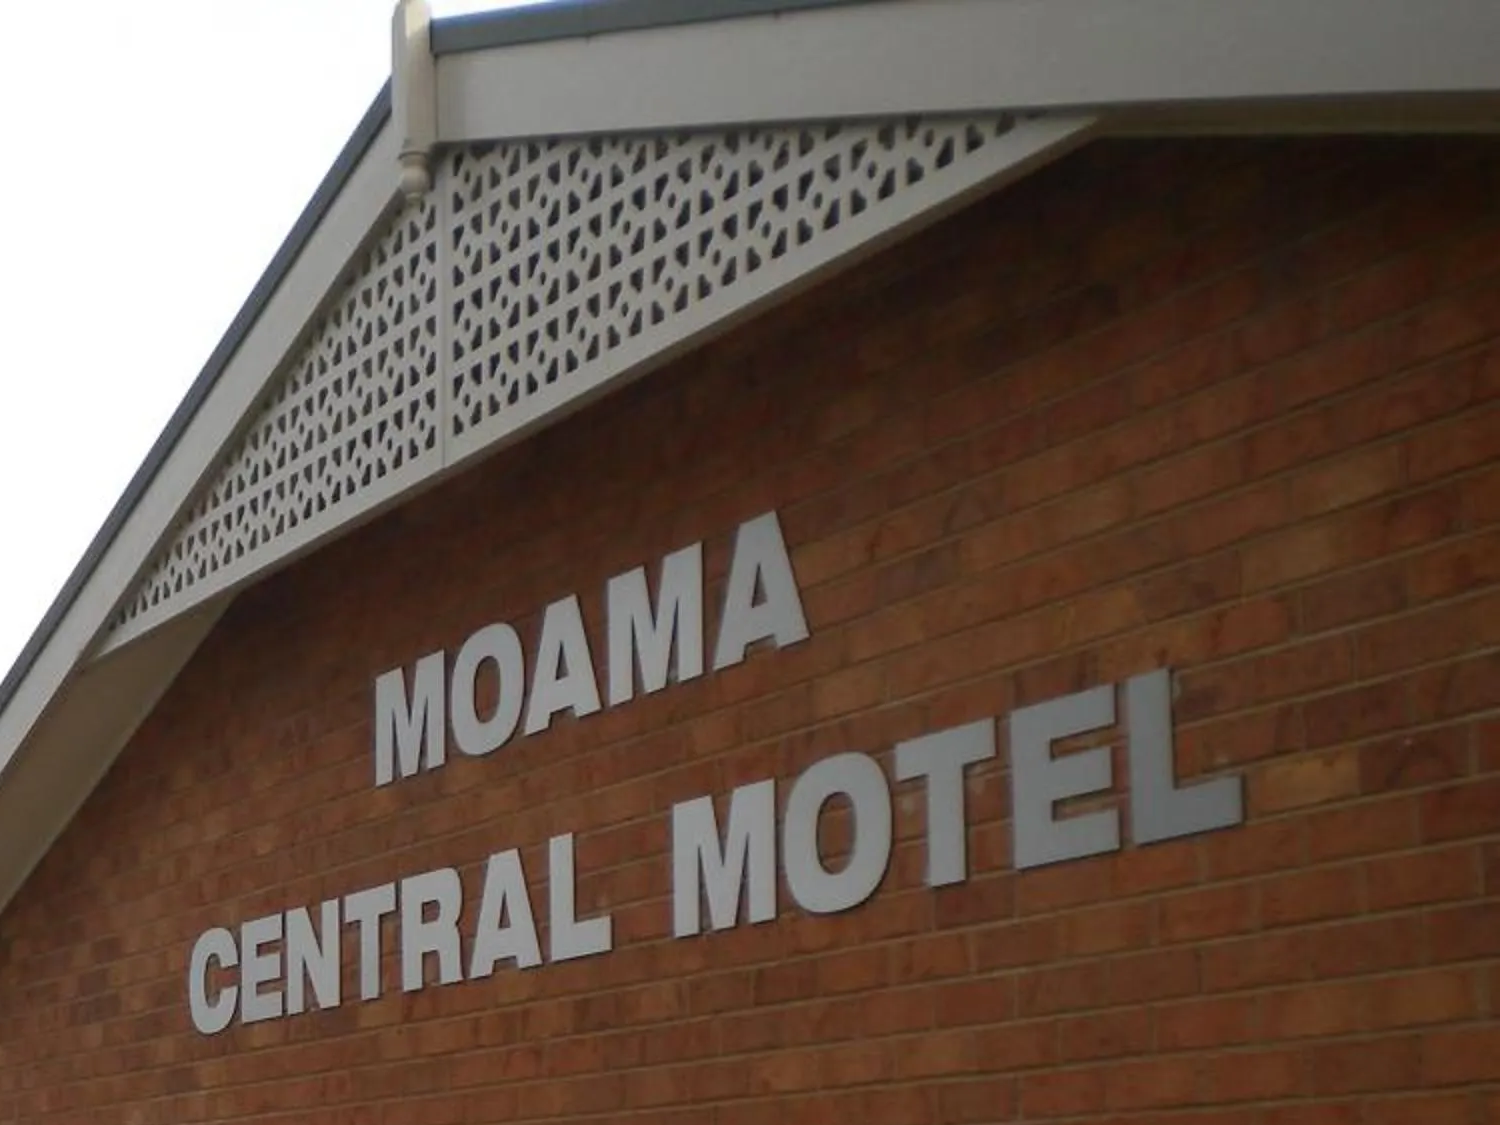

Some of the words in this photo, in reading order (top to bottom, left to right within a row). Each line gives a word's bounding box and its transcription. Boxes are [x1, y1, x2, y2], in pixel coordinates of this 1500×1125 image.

[375, 509, 809, 786] MOAMA
[188, 831, 613, 1035] CENTRAL
[672, 667, 1243, 938] MOTEL
